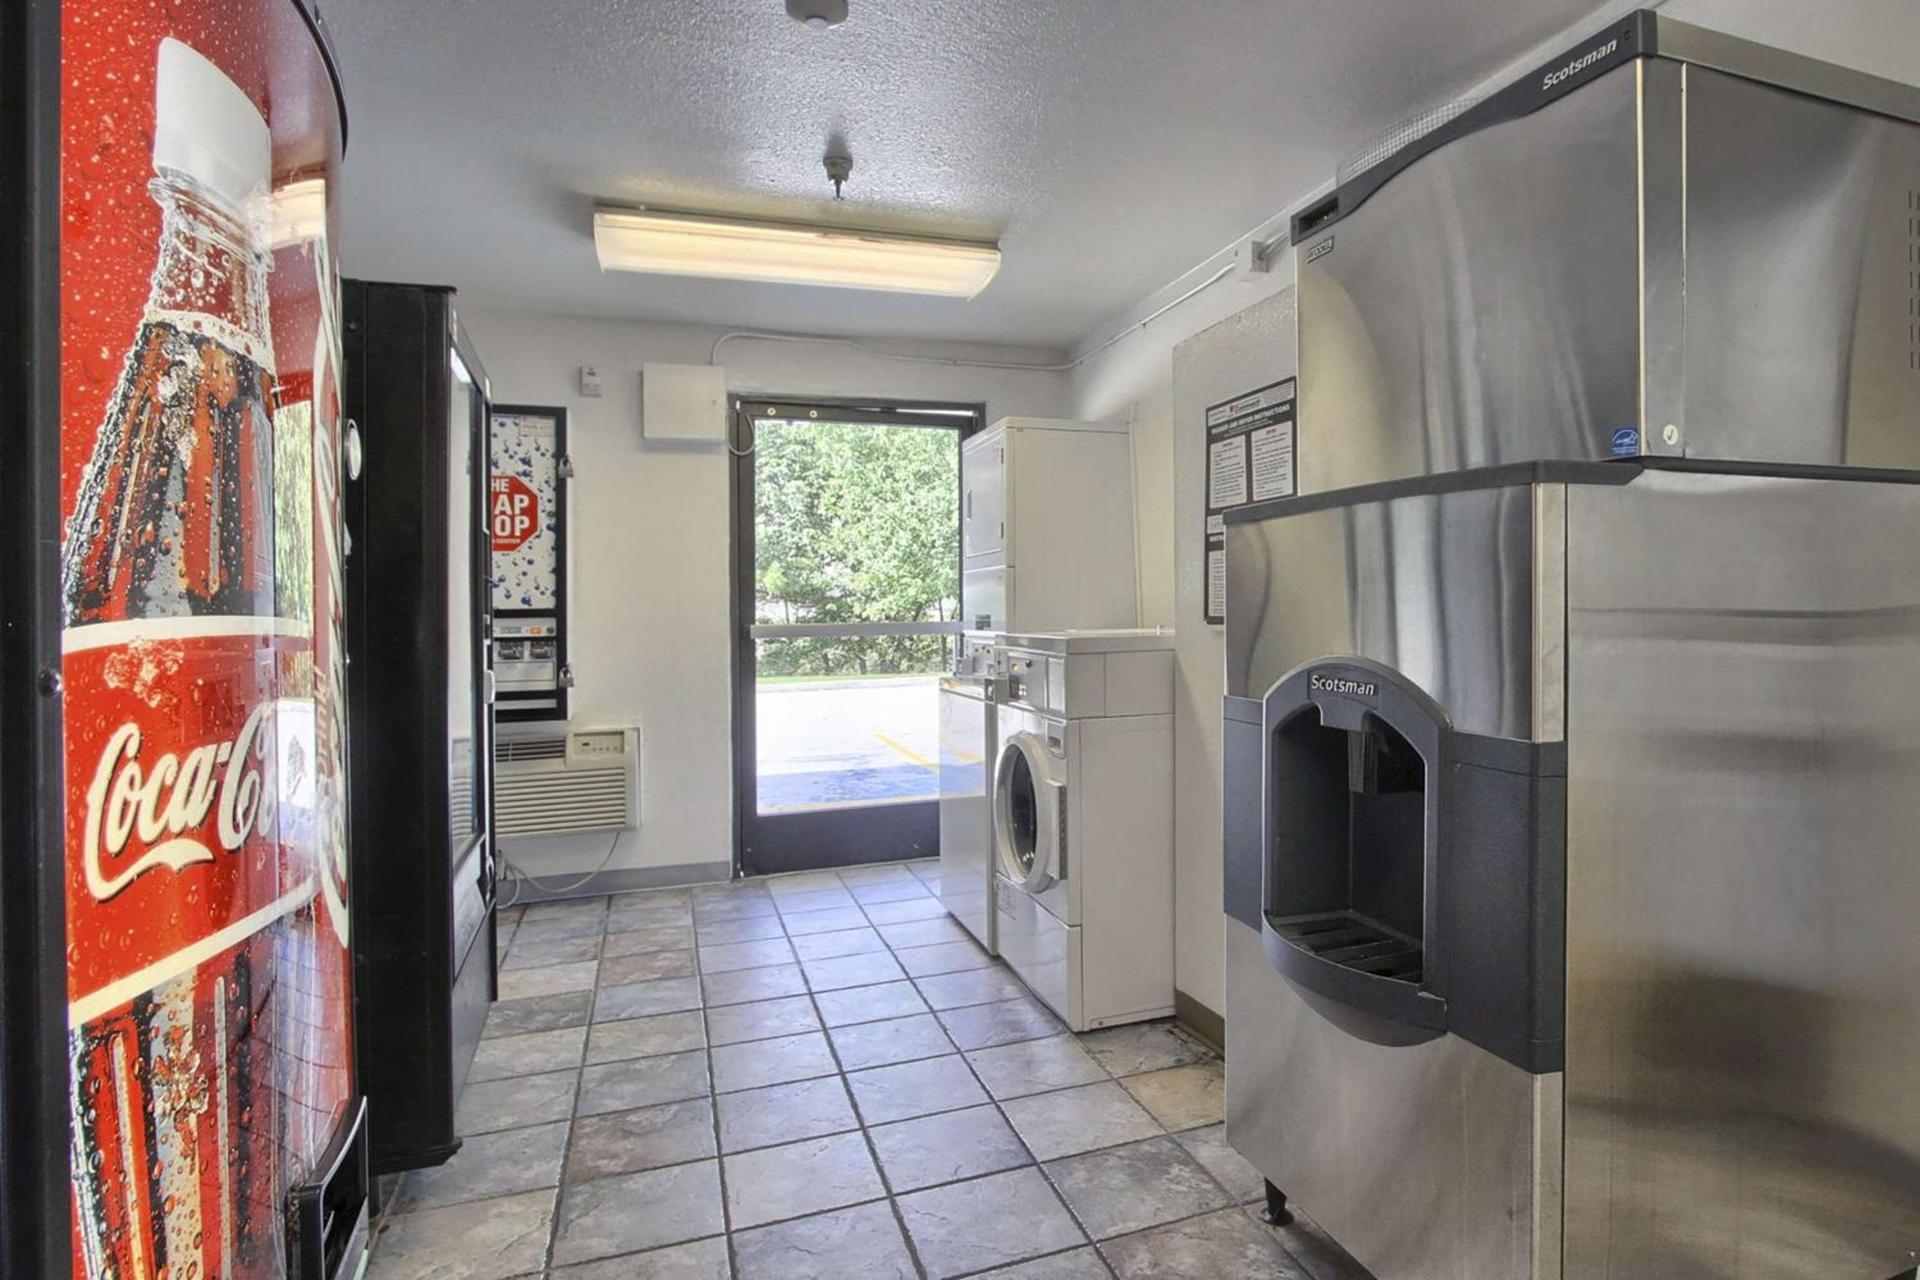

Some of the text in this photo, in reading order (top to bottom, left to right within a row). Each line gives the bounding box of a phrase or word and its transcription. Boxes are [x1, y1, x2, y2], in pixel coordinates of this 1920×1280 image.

[1542, 39, 1617, 91] Scotsman
[492, 478, 510, 492] HE
[494, 494, 530, 515] AP
[494, 515, 530, 537] OP
[1311, 675, 1375, 696] Scotsman
[84, 700, 276, 903] Coca-Col
